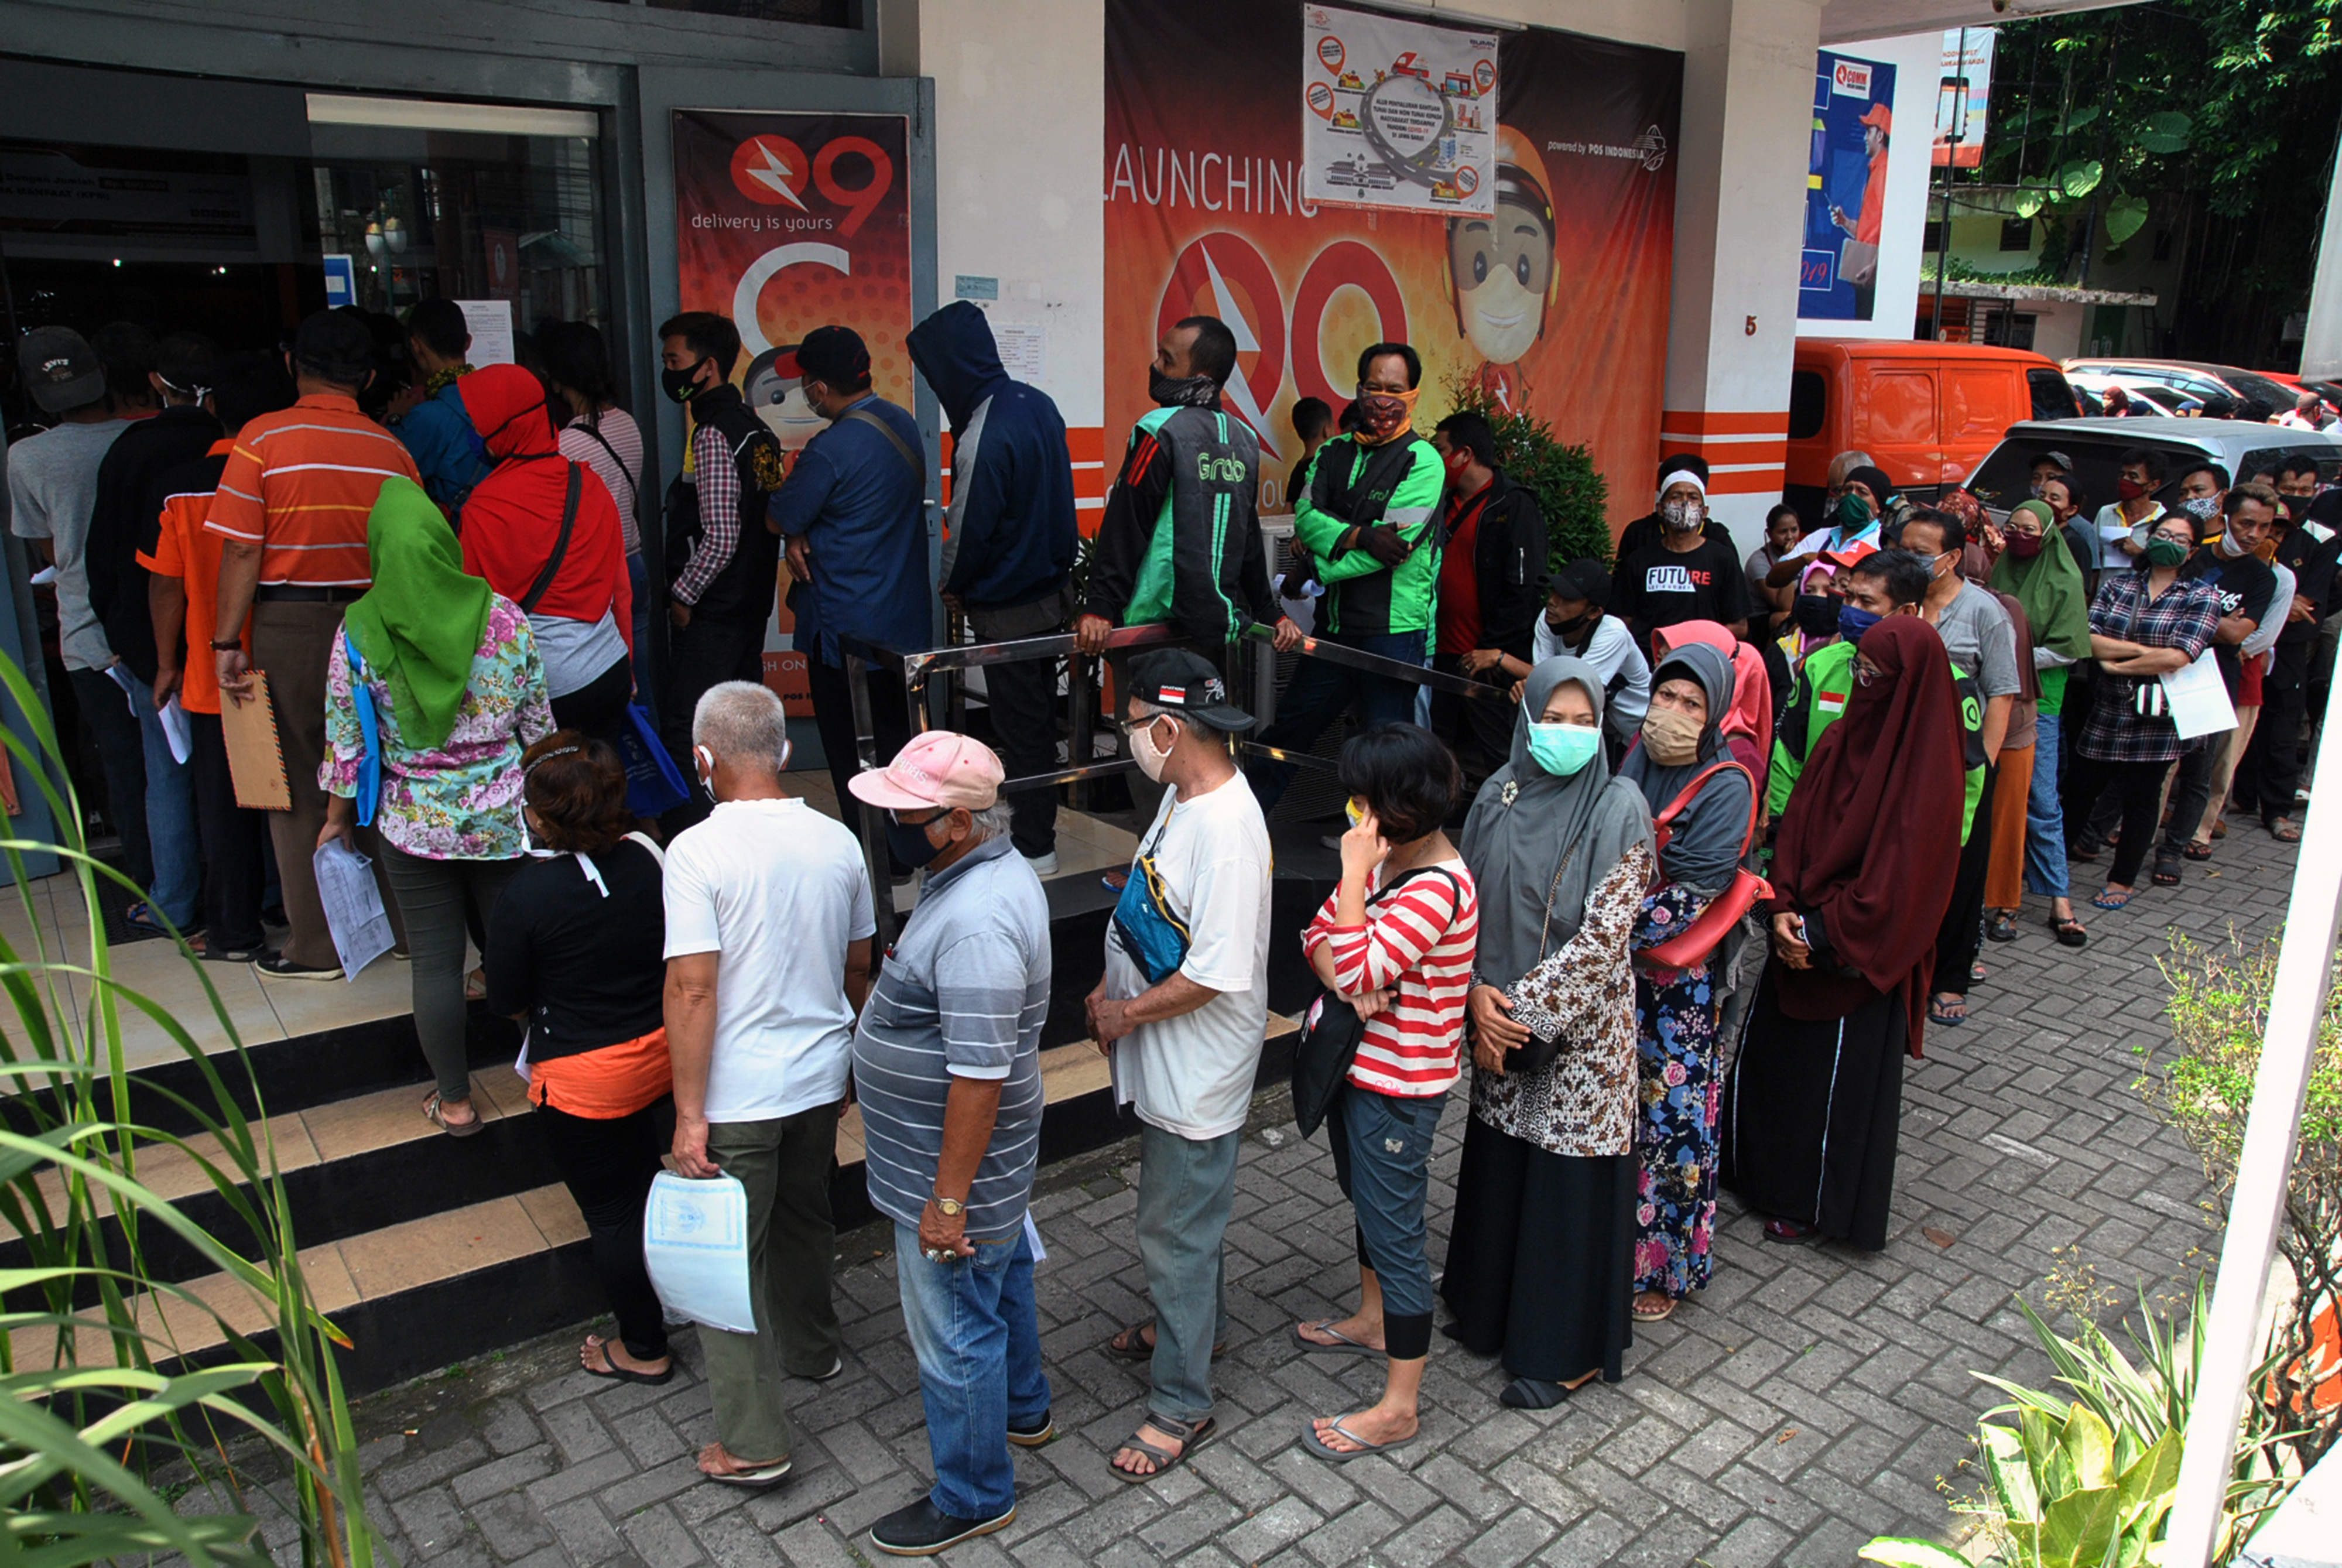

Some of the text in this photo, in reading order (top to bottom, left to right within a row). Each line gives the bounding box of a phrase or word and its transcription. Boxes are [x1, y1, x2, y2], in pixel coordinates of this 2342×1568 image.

[1547, 142, 1644, 159] powered by POS INDONESIA
[692, 214, 833, 232] delivery is yours
[1745, 315, 1757, 336] 5
[1198, 451, 1245, 482] Grab
[782, 659, 806, 670] ON
